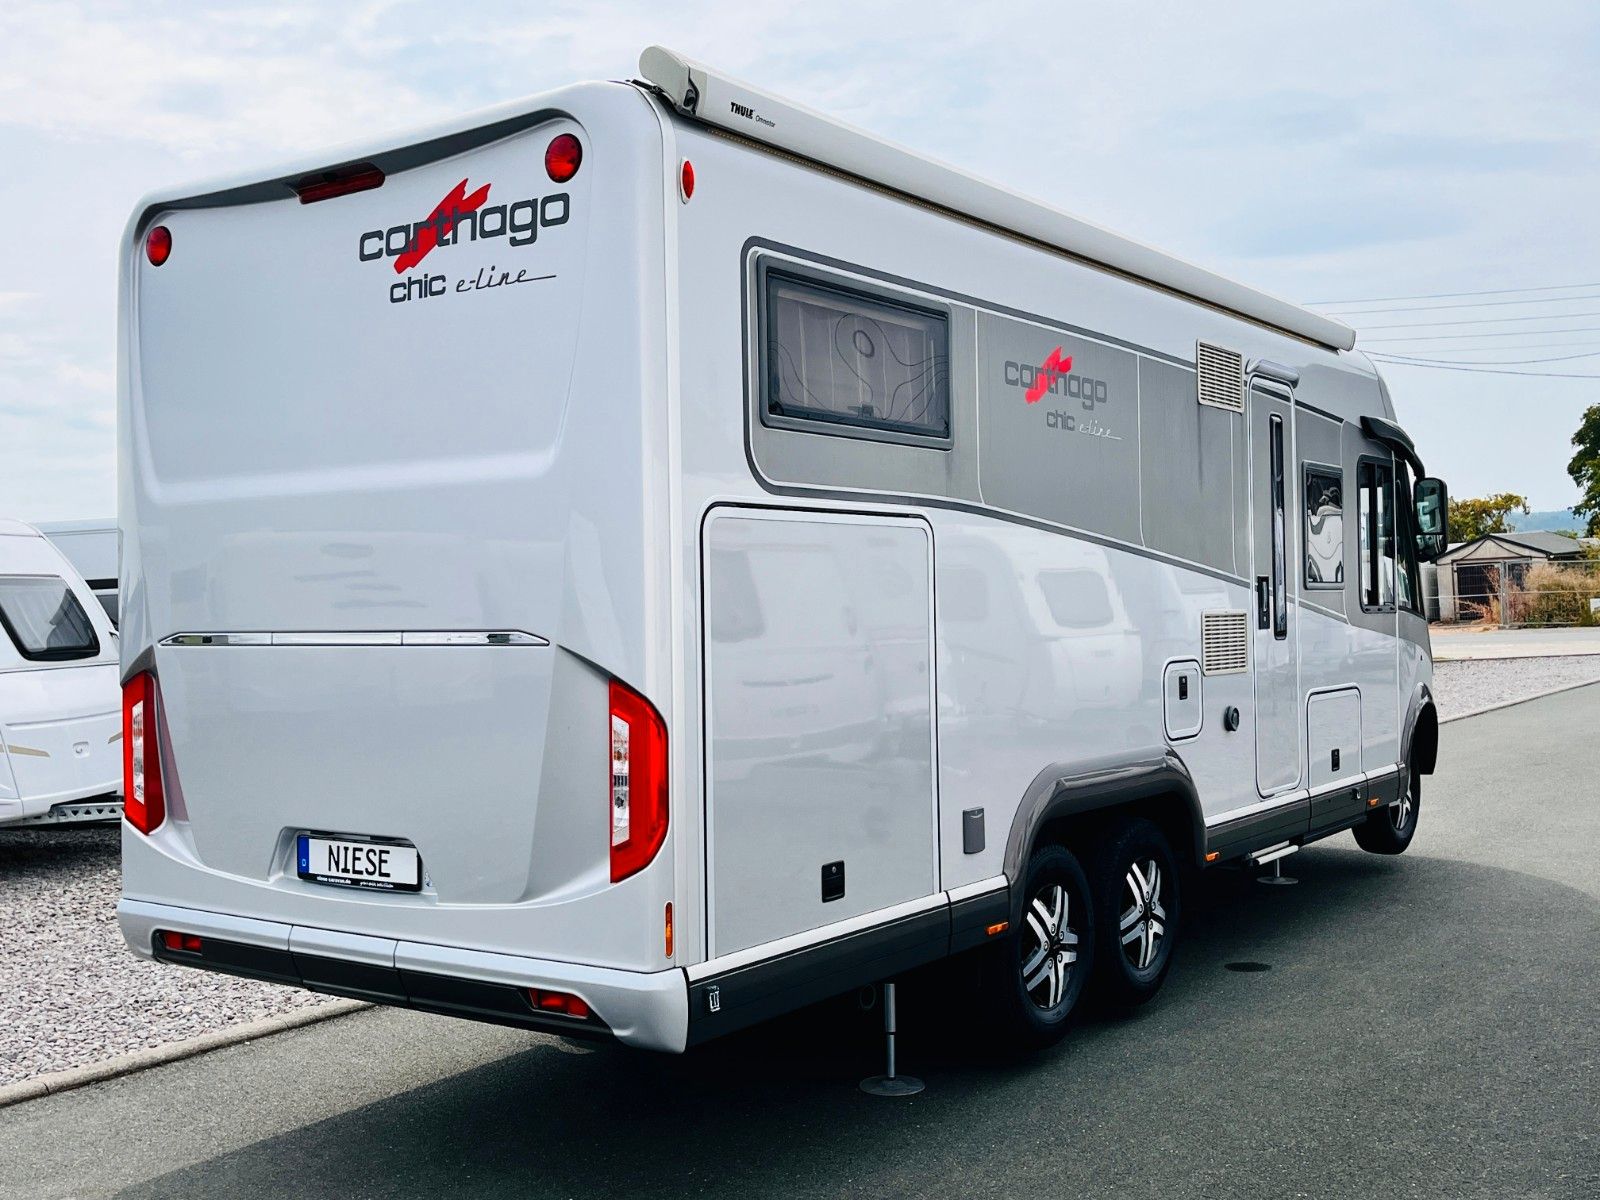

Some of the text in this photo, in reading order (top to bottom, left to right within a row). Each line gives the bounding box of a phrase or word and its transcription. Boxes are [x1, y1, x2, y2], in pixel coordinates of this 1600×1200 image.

[730, 101, 754, 120] THULE
[359, 192, 570, 262] carthago
[390, 273, 447, 304] chic
[1004, 360, 1107, 411] carthago
[1046, 409, 1075, 431] chic
[327, 844, 391, 878] NIESE
